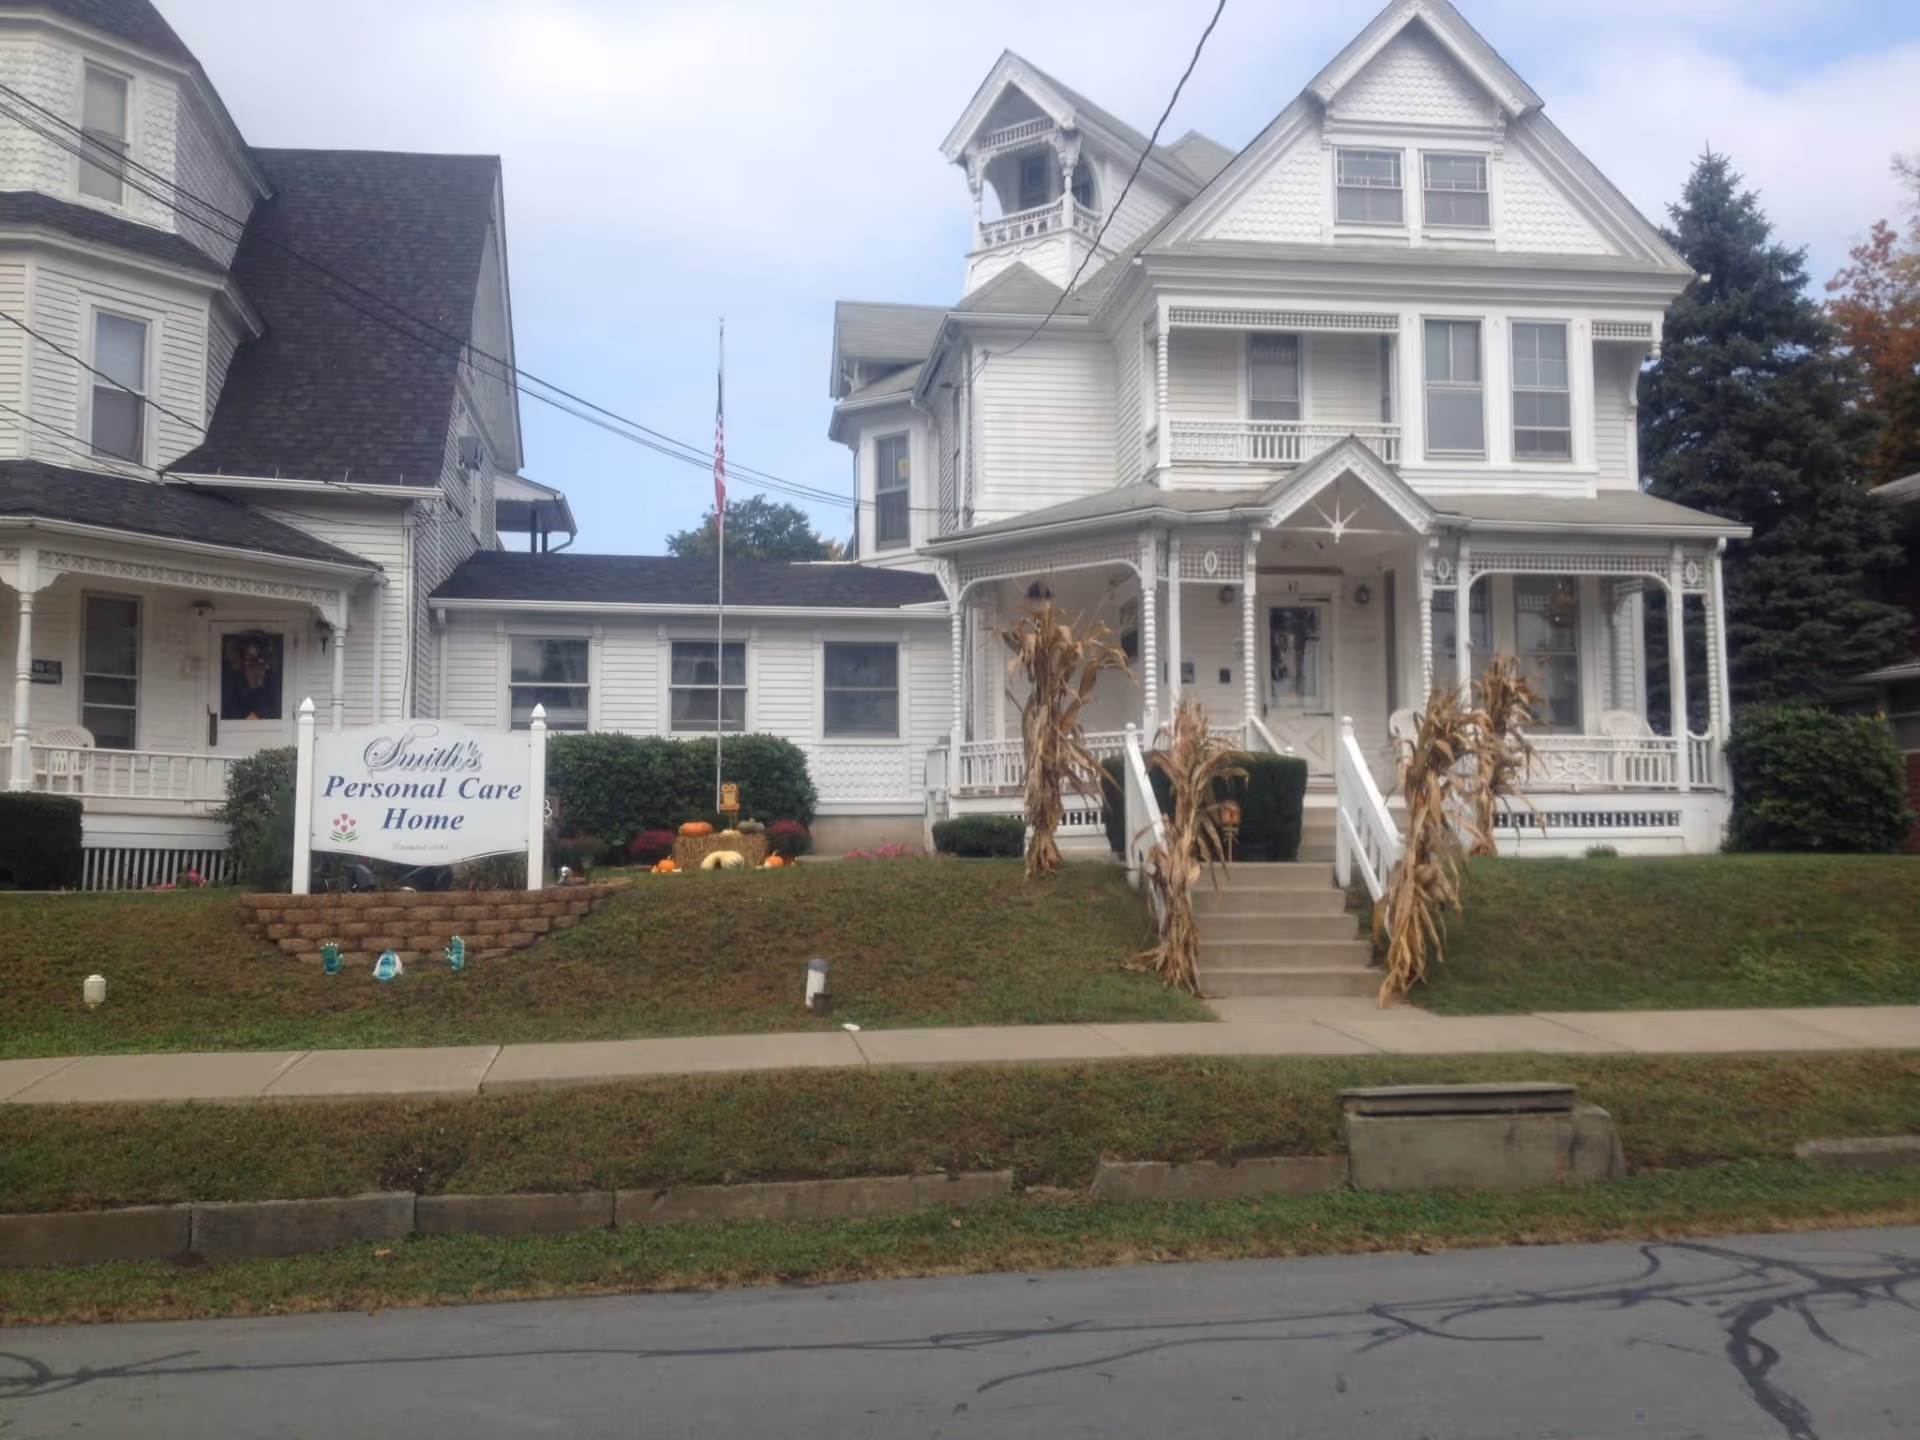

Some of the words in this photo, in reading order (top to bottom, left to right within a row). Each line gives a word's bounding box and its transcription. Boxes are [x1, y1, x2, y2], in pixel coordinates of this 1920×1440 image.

[363, 723, 484, 778] Smith's
[322, 775, 448, 799] Personal
[458, 777, 522, 800] Care
[380, 807, 466, 831] Home
